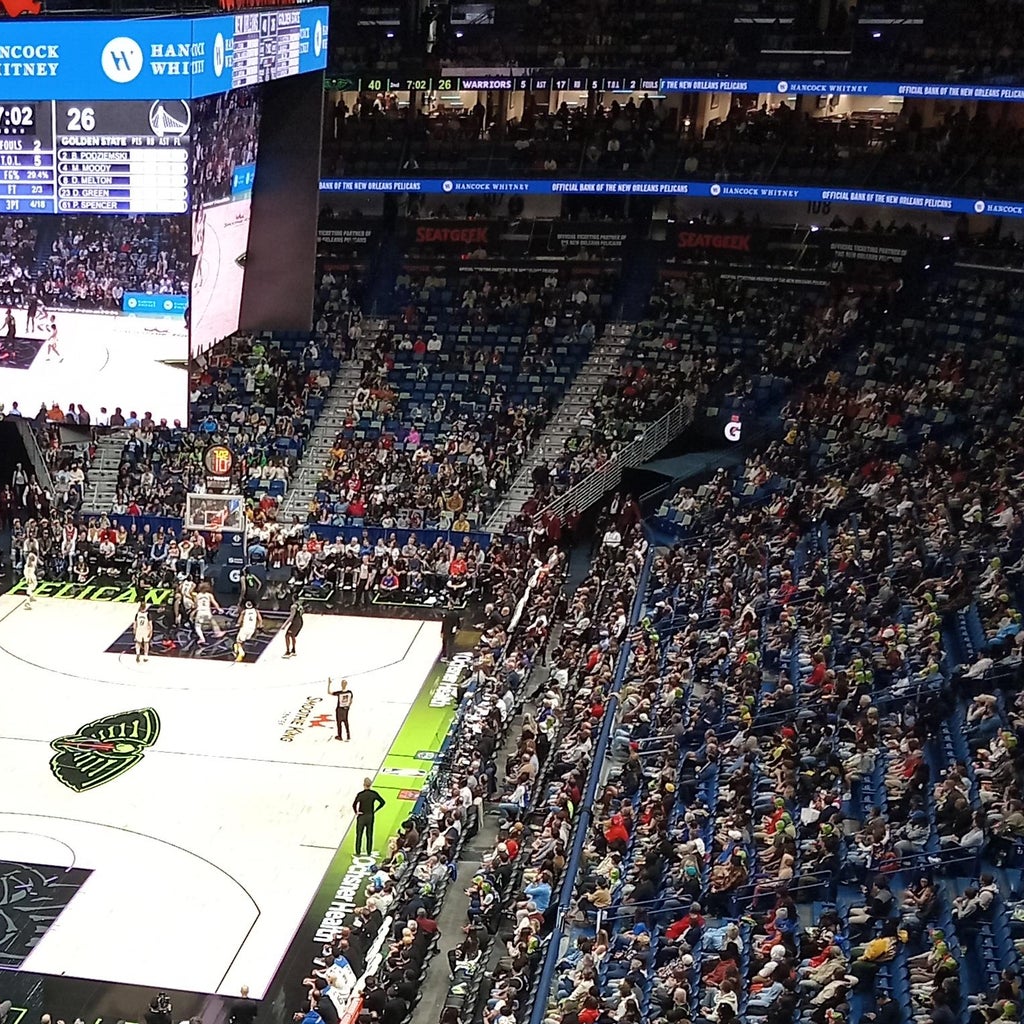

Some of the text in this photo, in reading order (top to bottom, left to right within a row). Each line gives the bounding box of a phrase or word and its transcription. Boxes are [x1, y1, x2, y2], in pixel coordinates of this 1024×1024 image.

[368, 80, 382, 91] 40
[406, 80, 427, 90] 7:02
[438, 79, 452, 90] 26
[462, 79, 512, 89] WARRIORS
[520, 80, 527, 89] 5
[556, 80, 566, 89] 17
[591, 80, 598, 89] 5
[629, 80, 637, 89] 2
[667, 80, 748, 91] THE NEW ORLEANS PELICANS
[790, 84, 869, 93] HANCOCK WHITNEY
[66, 107, 96, 131] 26
[0, 140, 23, 151] FOULS
[33, 139, 42, 151] 2
[60, 136, 128, 147] GOLDEN STATE
[34, 154, 42, 167] 5
[81, 164, 111, 172] MOODY
[81, 177, 113, 185] MELTON
[334, 181, 343, 191] OF
[343, 181, 354, 191] THE
[368, 181, 393, 191] ORLEANS
[394, 182, 422, 191] PELICANS
[7, 184, 17, 195] FT
[455, 183, 530, 191] HANCOCK WHITNEY
[552, 183, 689, 194] OFFICIAL BANK OF THE NEW ORLEANS PELICANS
[722, 187, 800, 198] HANCOCK WHITNEY
[60, 189, 71, 198] 23
[82, 189, 110, 198] GREEN
[822, 190, 850, 201] OFFICIAL
[850, 192, 866, 202] BANK
[866, 193, 875, 202] OF
[875, 193, 886, 203] THE
[924, 198, 953, 209] PELICANS
[81, 202, 118, 210] SPENCER
[986, 204, 1023, 214] HANCOCK
[416, 227, 489, 243] SEATGEEK
[677, 231, 751, 250] SEATGEEK
[724, 421, 741, 442] G
[229, 569, 240, 583] G
